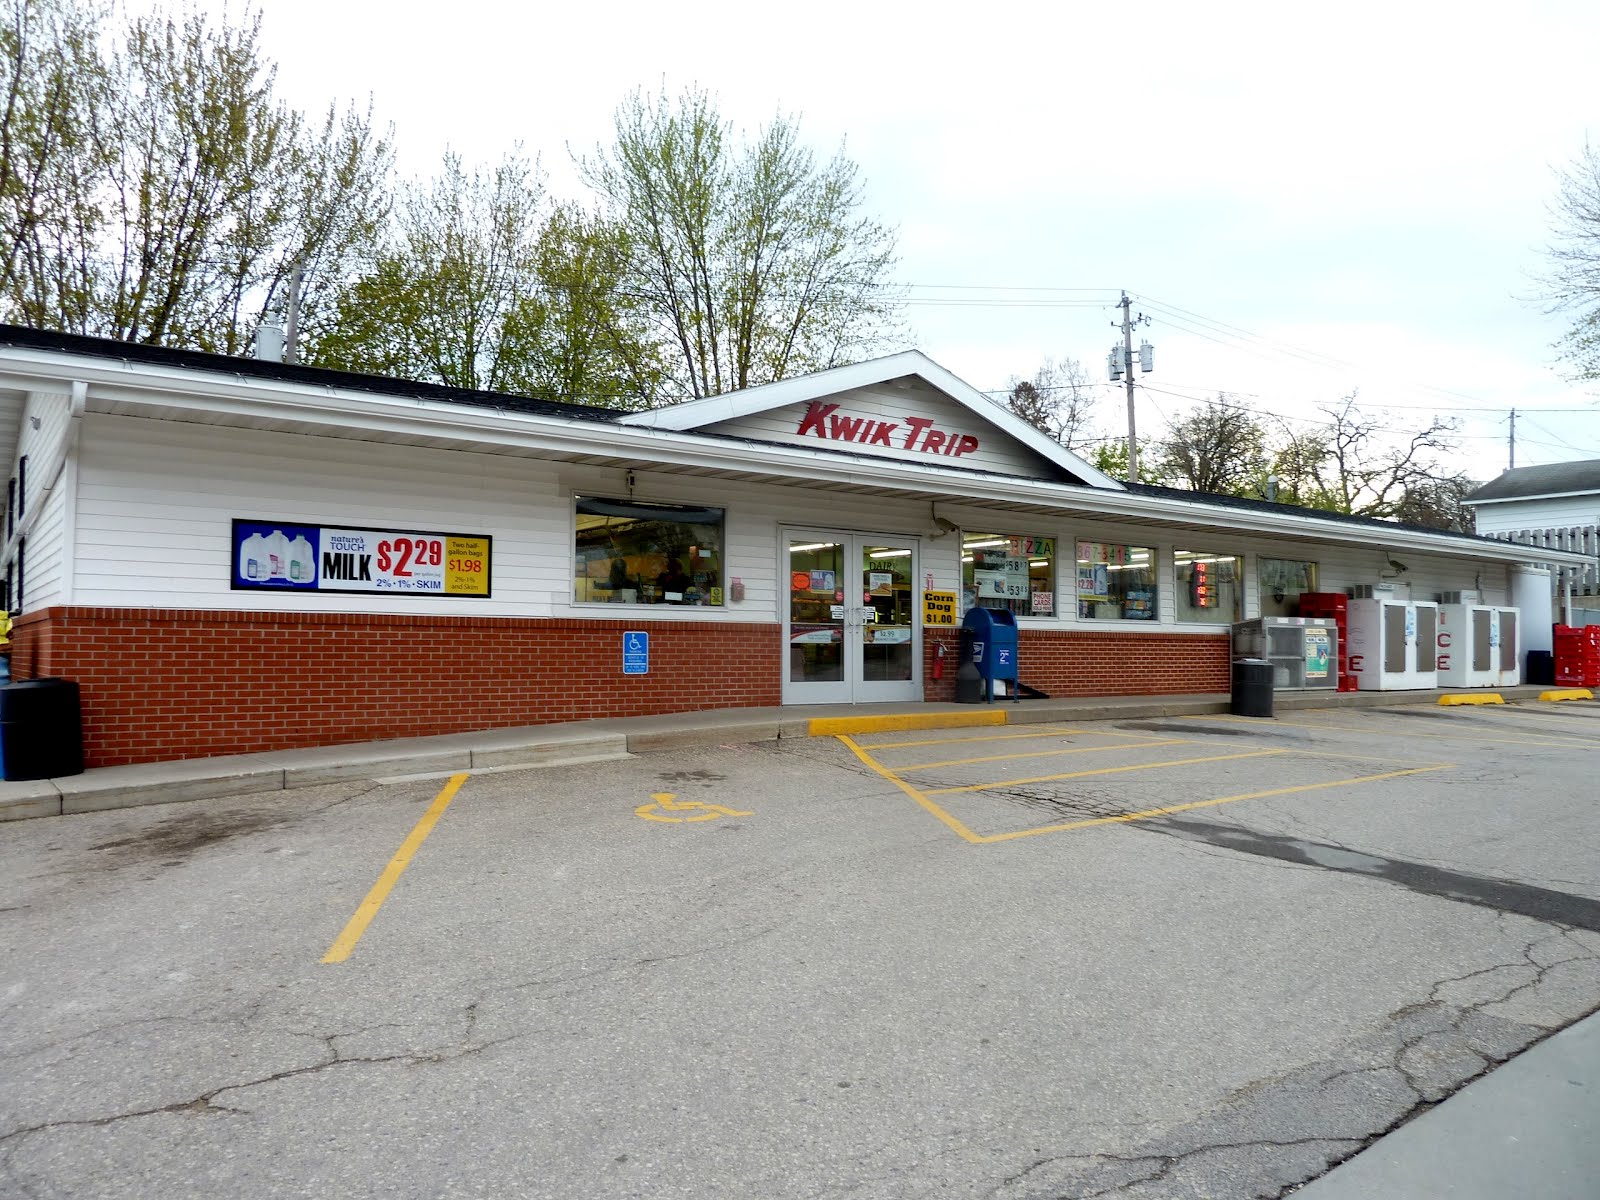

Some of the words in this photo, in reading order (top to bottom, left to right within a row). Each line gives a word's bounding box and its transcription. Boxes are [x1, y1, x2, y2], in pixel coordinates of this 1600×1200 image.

[330, 542, 365, 551] TOUCH
[1011, 540, 1052, 556] PIZZA
[323, 552, 372, 581] MILK
[449, 559, 482, 573] $1.98
[416, 580, 441, 589] SKIM
[925, 594, 953, 602] Corn
[928, 602, 951, 612] Dog
[926, 614, 952, 624] $1.00
